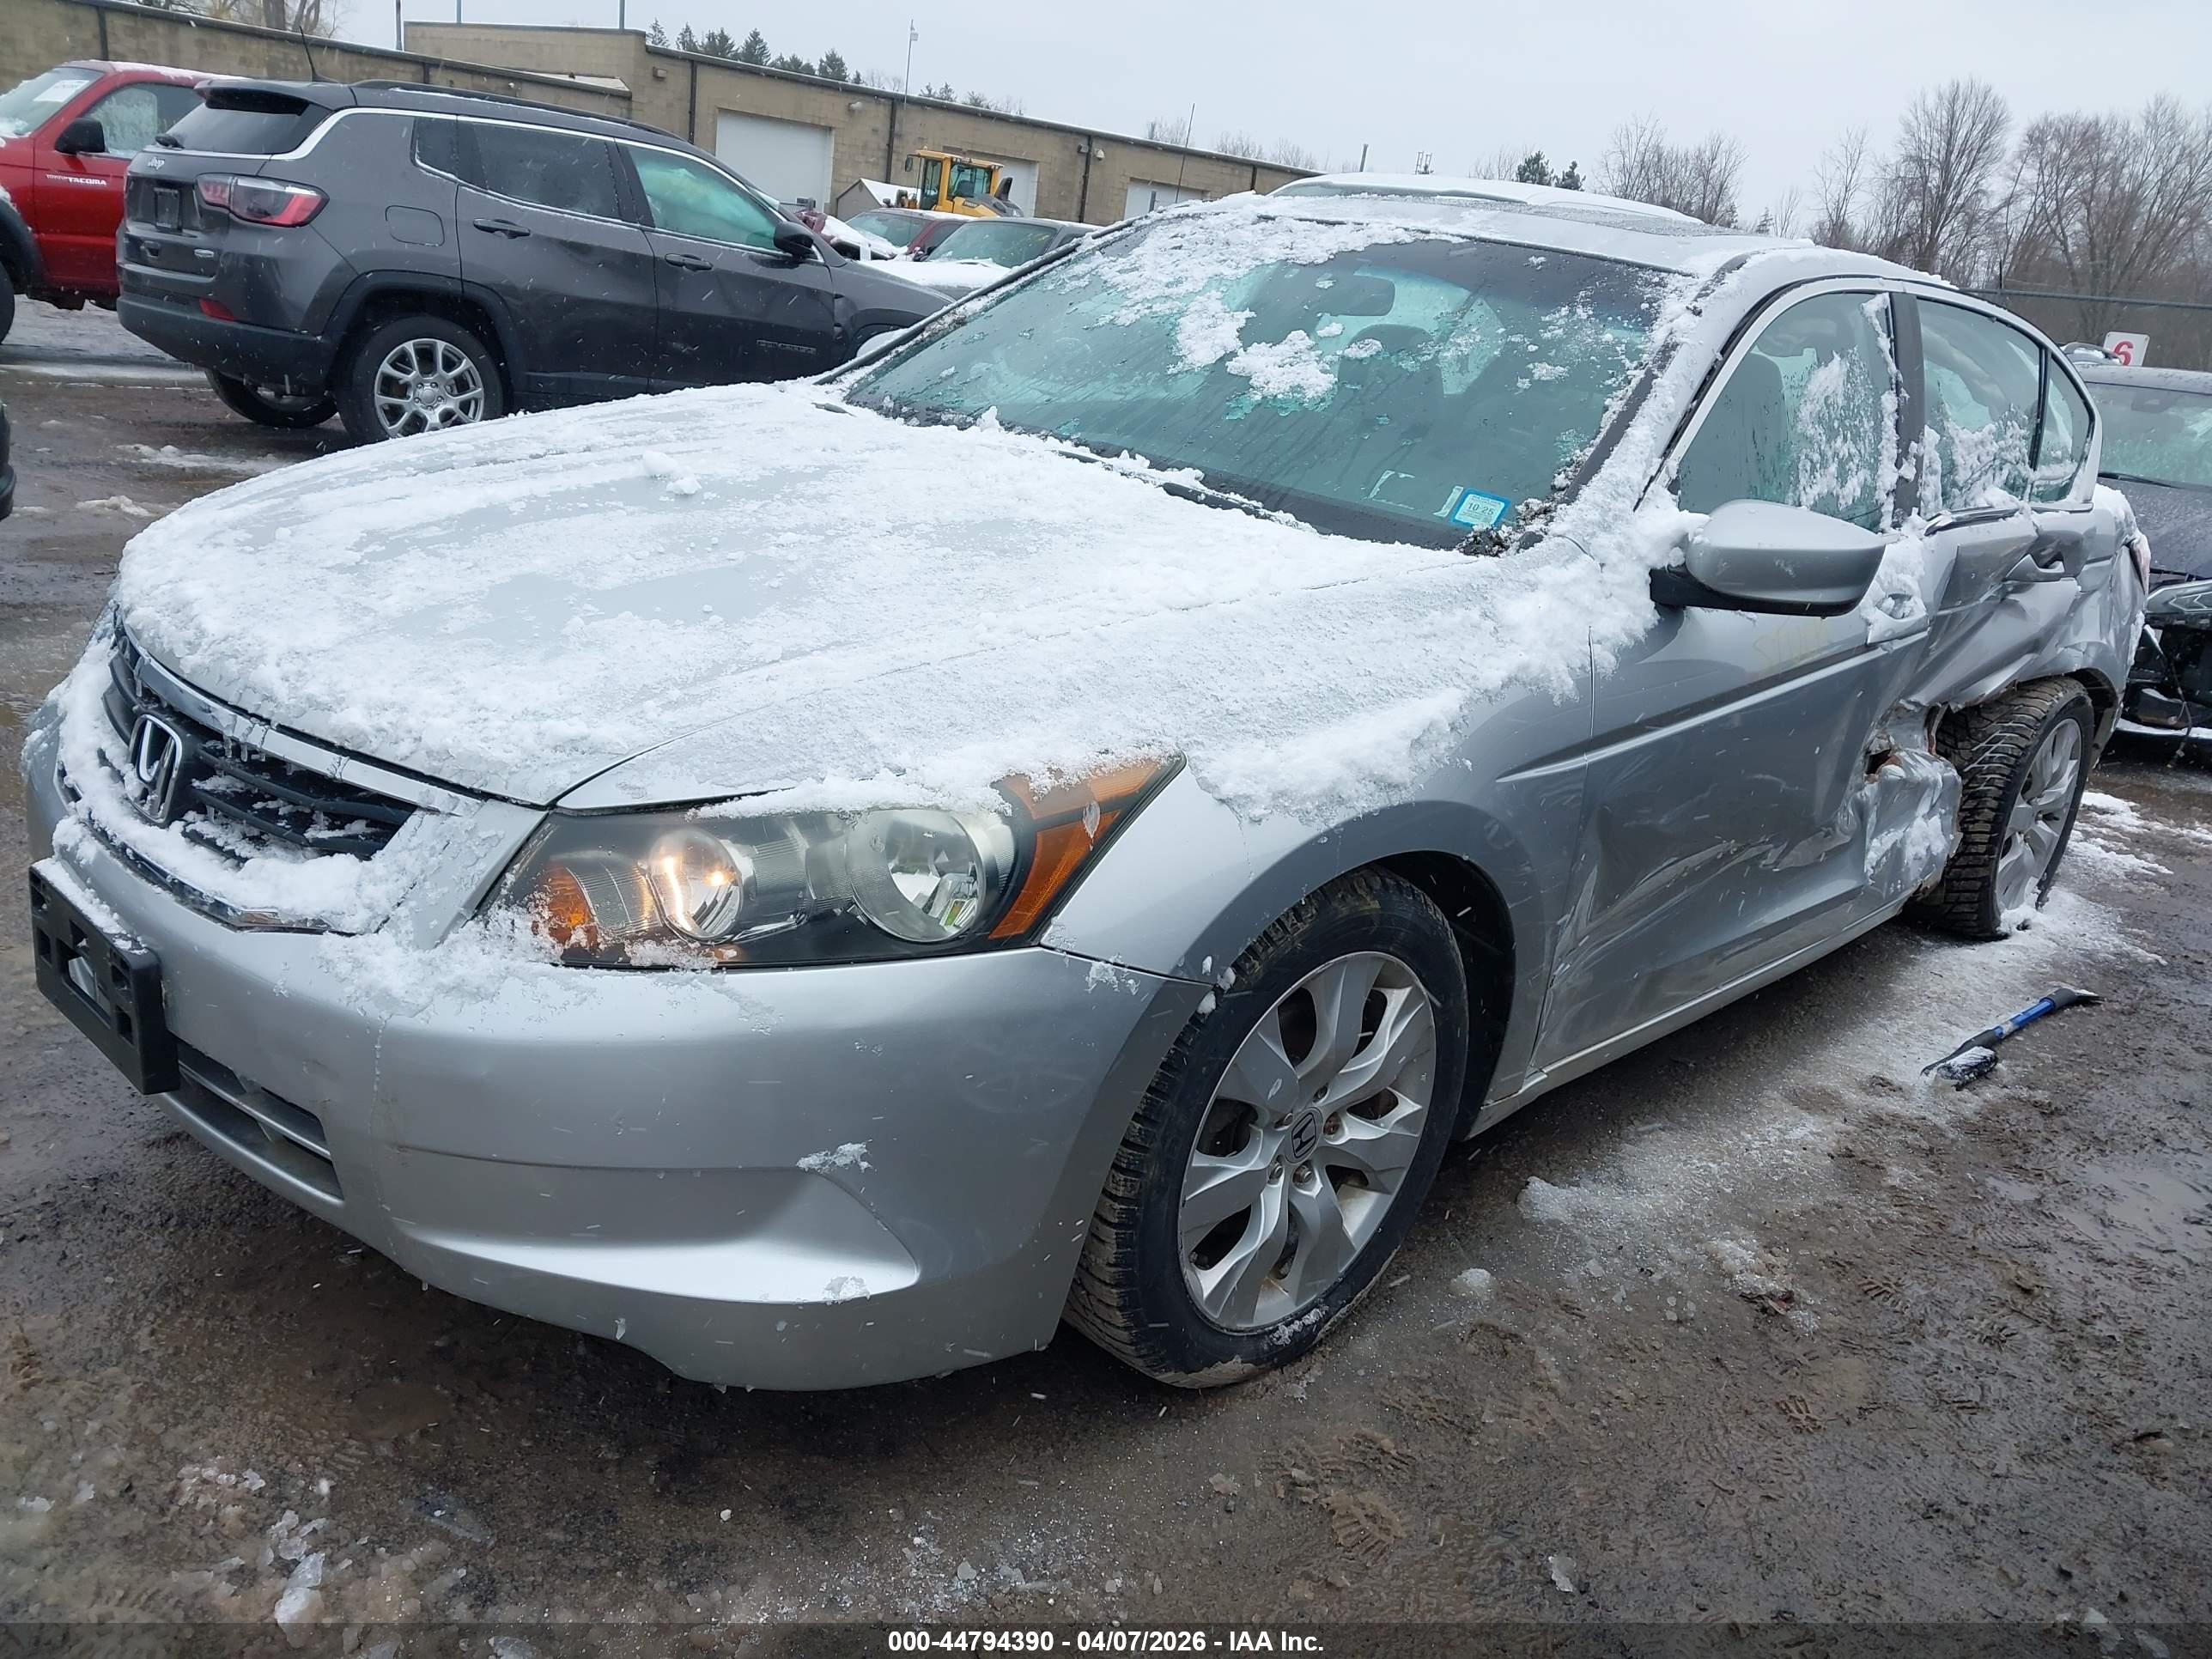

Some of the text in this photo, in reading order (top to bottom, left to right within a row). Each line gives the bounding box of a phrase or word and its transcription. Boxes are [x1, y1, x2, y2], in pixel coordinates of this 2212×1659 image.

[68, 177, 107, 185] TACOMA
[2114, 341, 2134, 367] 6
[1468, 502, 1495, 515] 10 25
